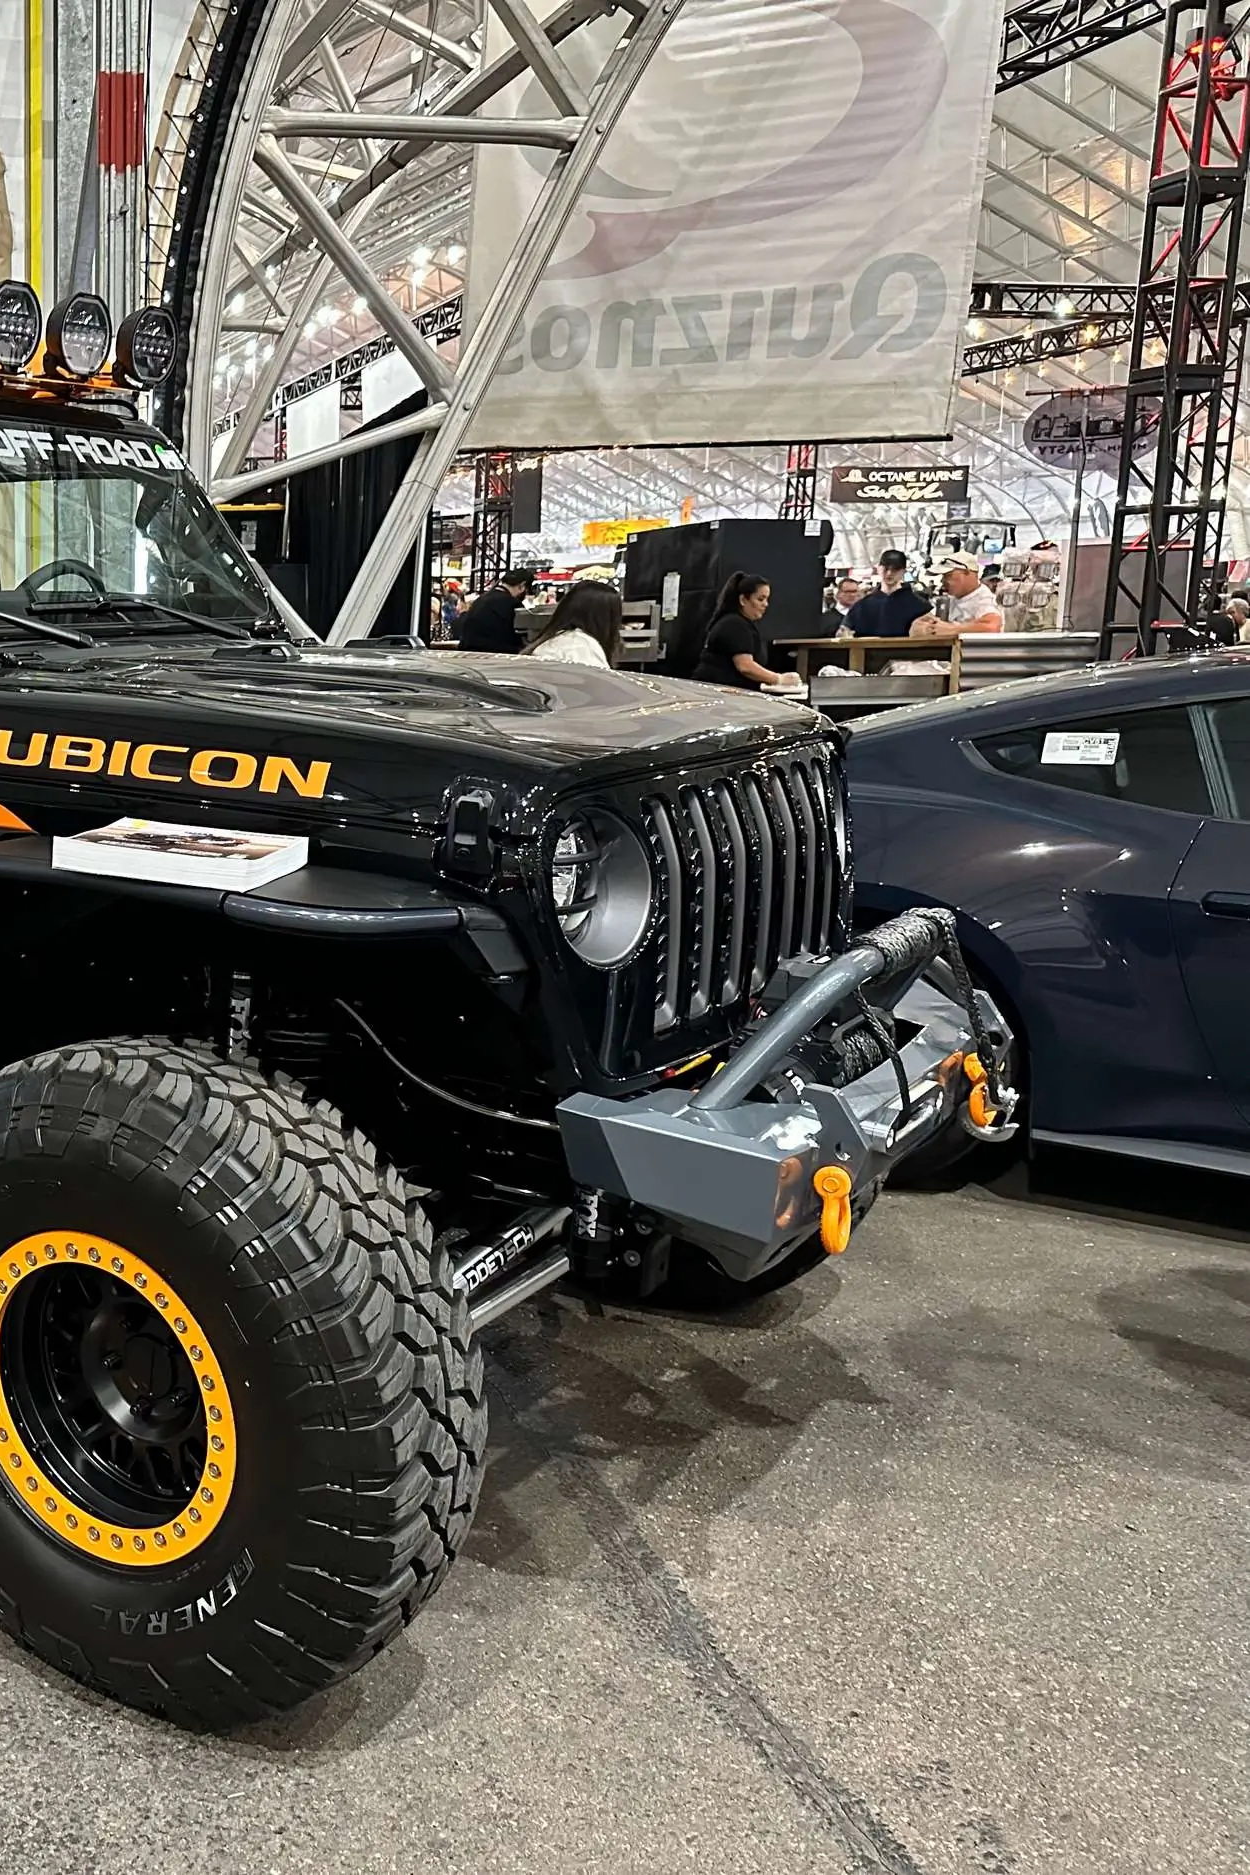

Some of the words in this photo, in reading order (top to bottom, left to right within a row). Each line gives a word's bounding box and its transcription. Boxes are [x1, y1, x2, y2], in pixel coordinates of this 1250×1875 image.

[868, 471, 917, 482] OCTANE
[919, 470, 964, 481] MARINE
[578, 1193, 599, 1239] FOX
[466, 1226, 535, 1291] DOETSCH
[91, 1547, 256, 1637] GENERAL
